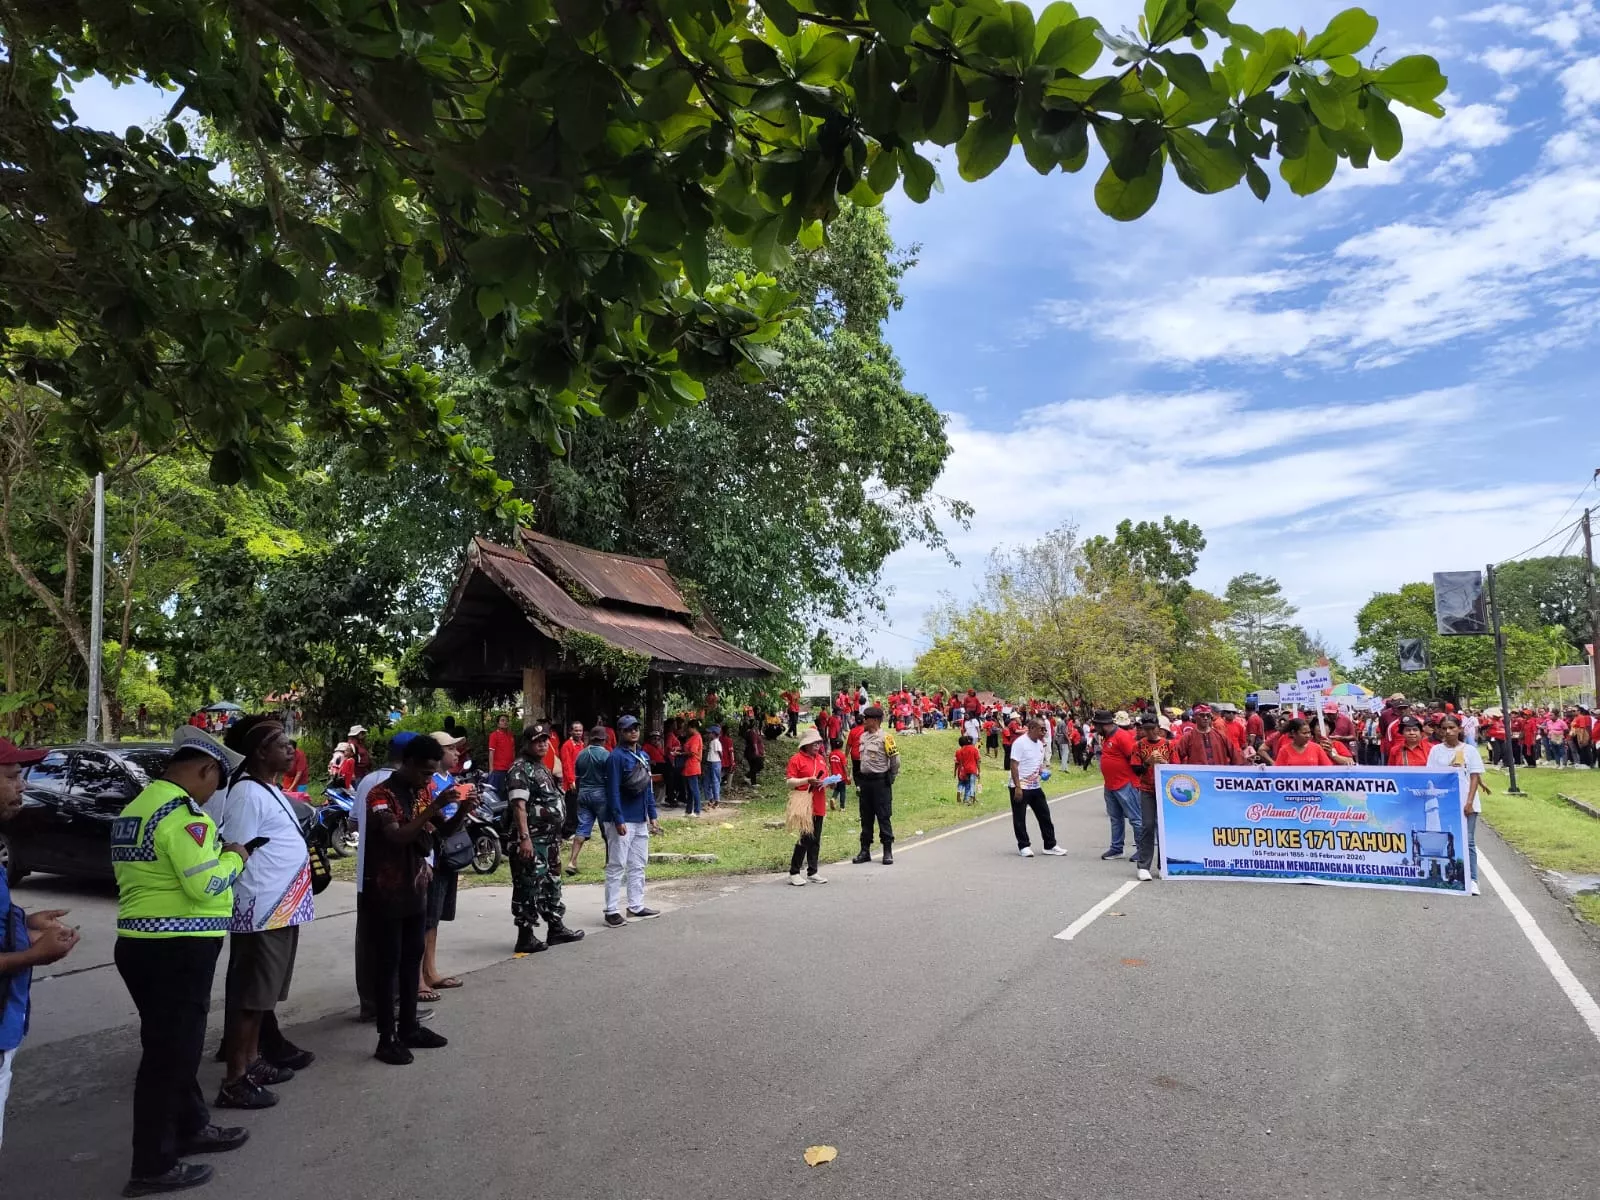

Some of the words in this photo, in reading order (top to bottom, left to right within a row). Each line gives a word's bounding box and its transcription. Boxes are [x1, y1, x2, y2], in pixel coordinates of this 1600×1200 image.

[1215, 778, 1272, 791] JEMAAT
[1275, 779, 1299, 792] GKI
[1302, 779, 1397, 793] MARANATHA
[1246, 804, 1297, 821] Selamat
[1299, 805, 1367, 825] Merayakan
[1213, 827, 1252, 847] HUT
[1254, 828, 1274, 848] PI
[1276, 829, 1302, 849] KE
[1303, 830, 1336, 849] 171
[1336, 831, 1407, 853] TAHUN
[1203, 858, 1225, 868] Tema
[1230, 859, 1285, 870] "PERTOBATAN
[1286, 860, 1354, 873] MENDATANGKAN
[1355, 863, 1420, 877] KESELAMATAN"
